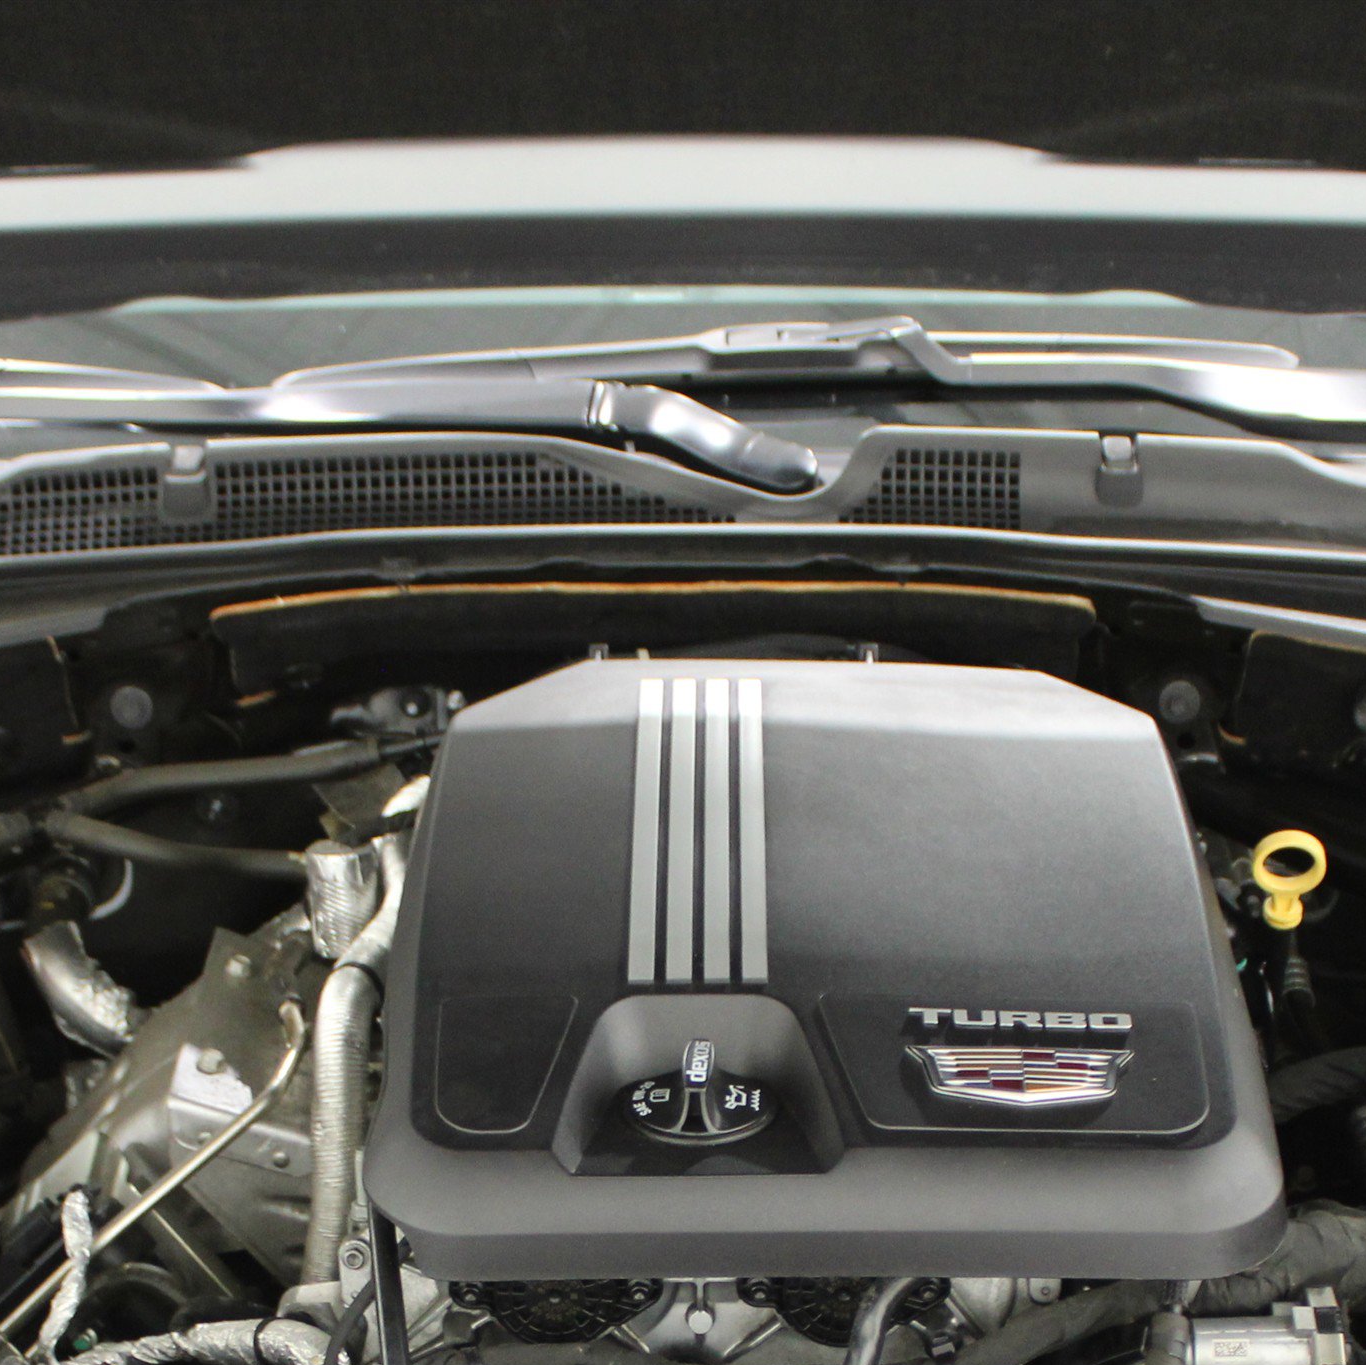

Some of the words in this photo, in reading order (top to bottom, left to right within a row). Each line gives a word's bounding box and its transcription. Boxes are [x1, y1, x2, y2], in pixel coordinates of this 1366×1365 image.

[908, 1007, 1133, 1029] TURBO
[686, 1041, 711, 1082] dexos
[633, 1101, 653, 1116] SAE
